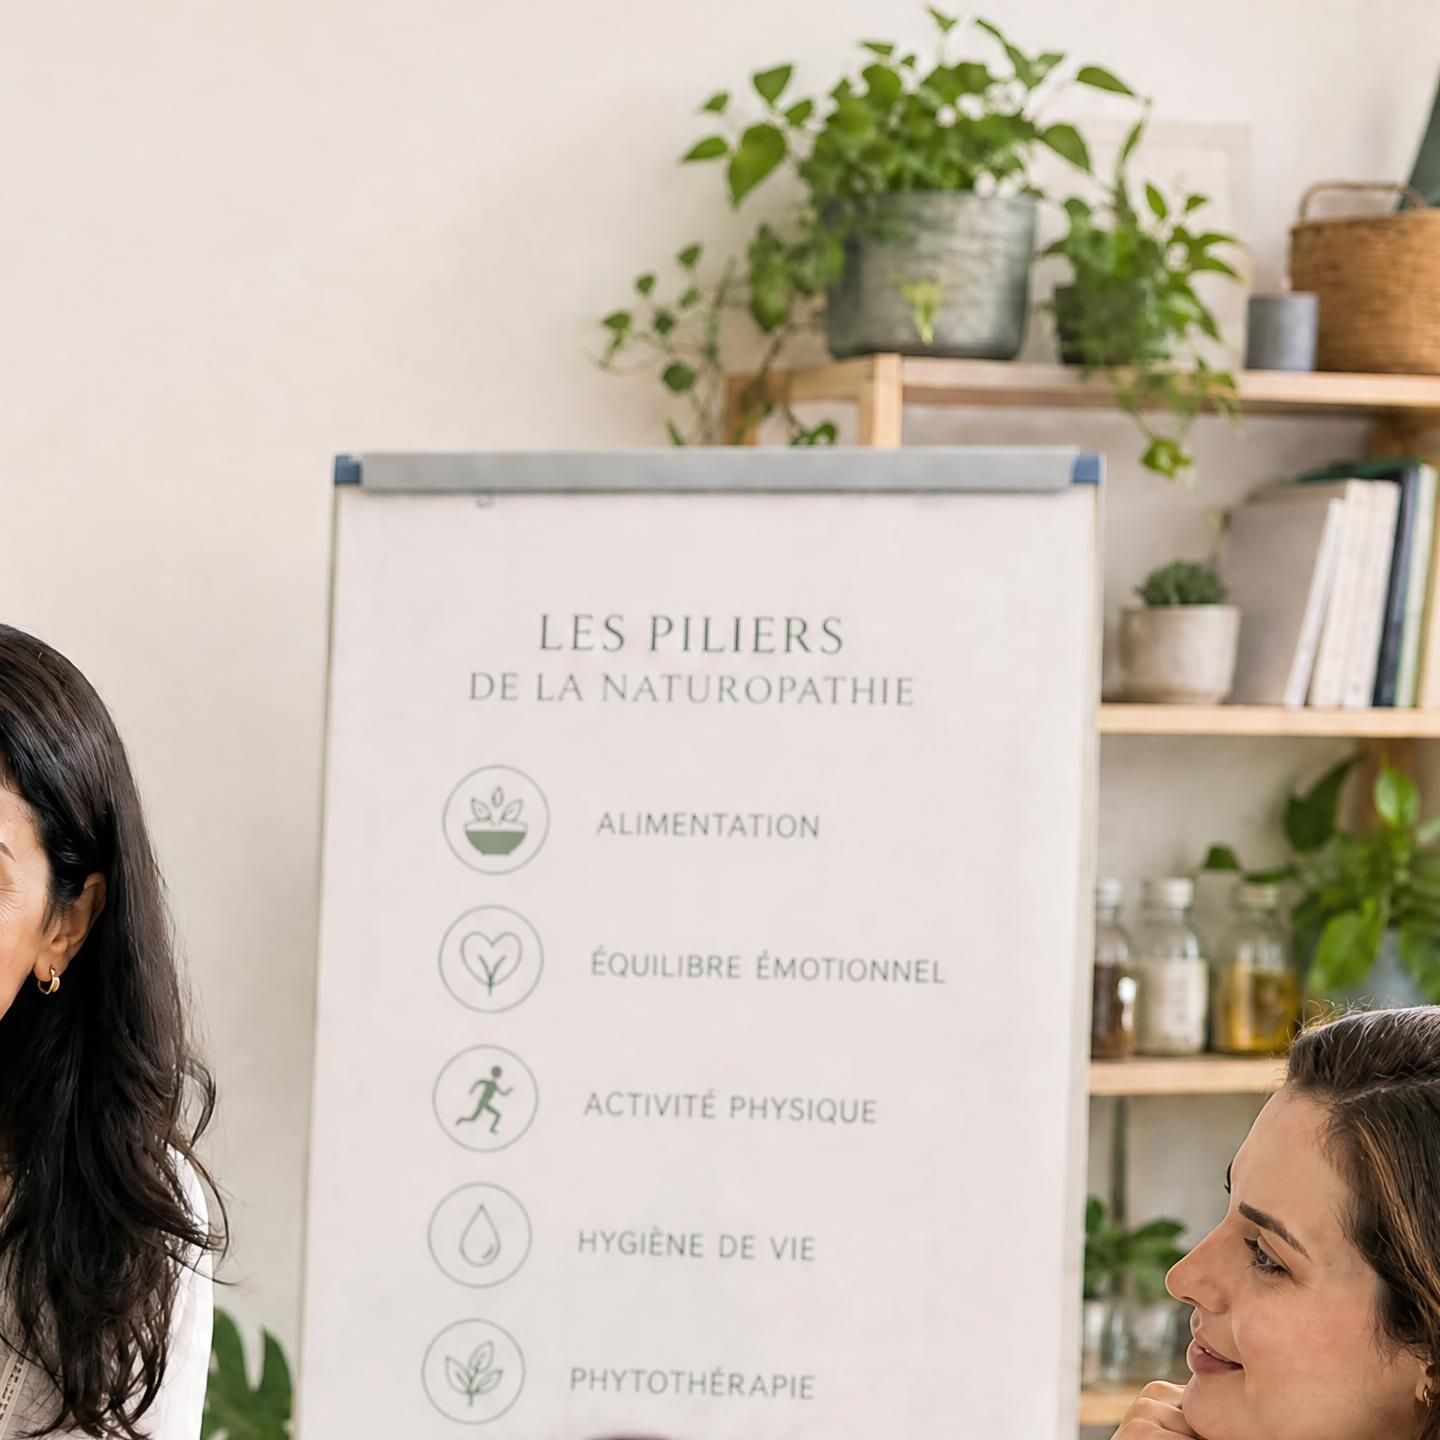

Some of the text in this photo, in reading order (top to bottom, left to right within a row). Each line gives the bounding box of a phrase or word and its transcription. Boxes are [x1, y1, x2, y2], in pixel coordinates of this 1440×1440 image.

[540, 614, 843, 654] LES PILIERS
[469, 671, 914, 706] DE LA NATUROPATHIE
[596, 812, 819, 839] ALIMENTATION
[591, 945, 945, 985] ÉQUILIBRE ÉMOTIONNEL
[583, 1089, 876, 1124] ACTIVITÉ PHYSIQUE
[578, 1226, 814, 1262] HYGIÈNE DE VIE
[570, 1366, 814, 1401] PHYTOTHÉRAPIE
